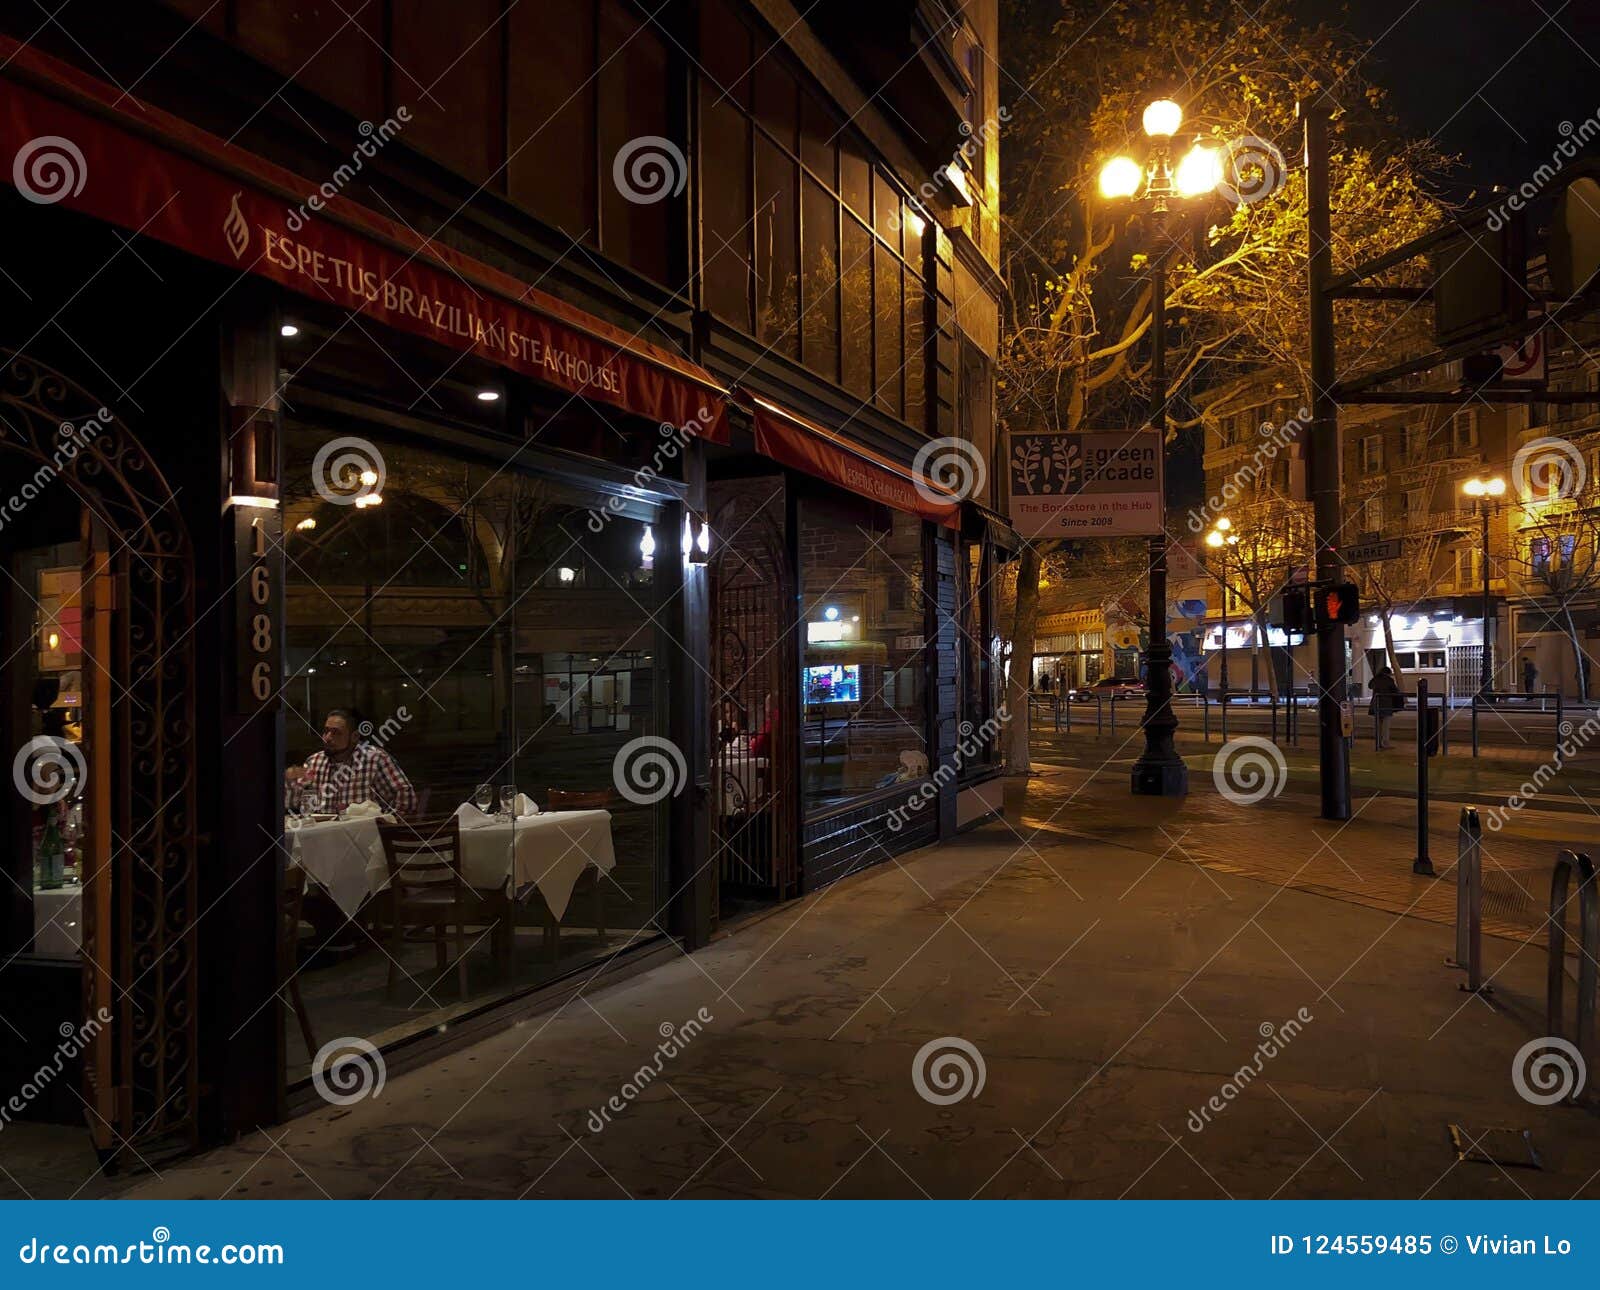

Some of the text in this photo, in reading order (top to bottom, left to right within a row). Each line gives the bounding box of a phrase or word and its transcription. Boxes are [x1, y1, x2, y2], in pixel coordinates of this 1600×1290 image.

[264, 228, 621, 394] ESPETUS BRAZILIAN STEAKHOUSE
[1096, 447, 1154, 466] green
[1084, 463, 1154, 481] arcade
[1020, 500, 1152, 513] The Bookstore in the Hub
[1061, 518, 1088, 527] Since
[1347, 544, 1390, 561] MARKET
[251, 517, 272, 702] 1686
